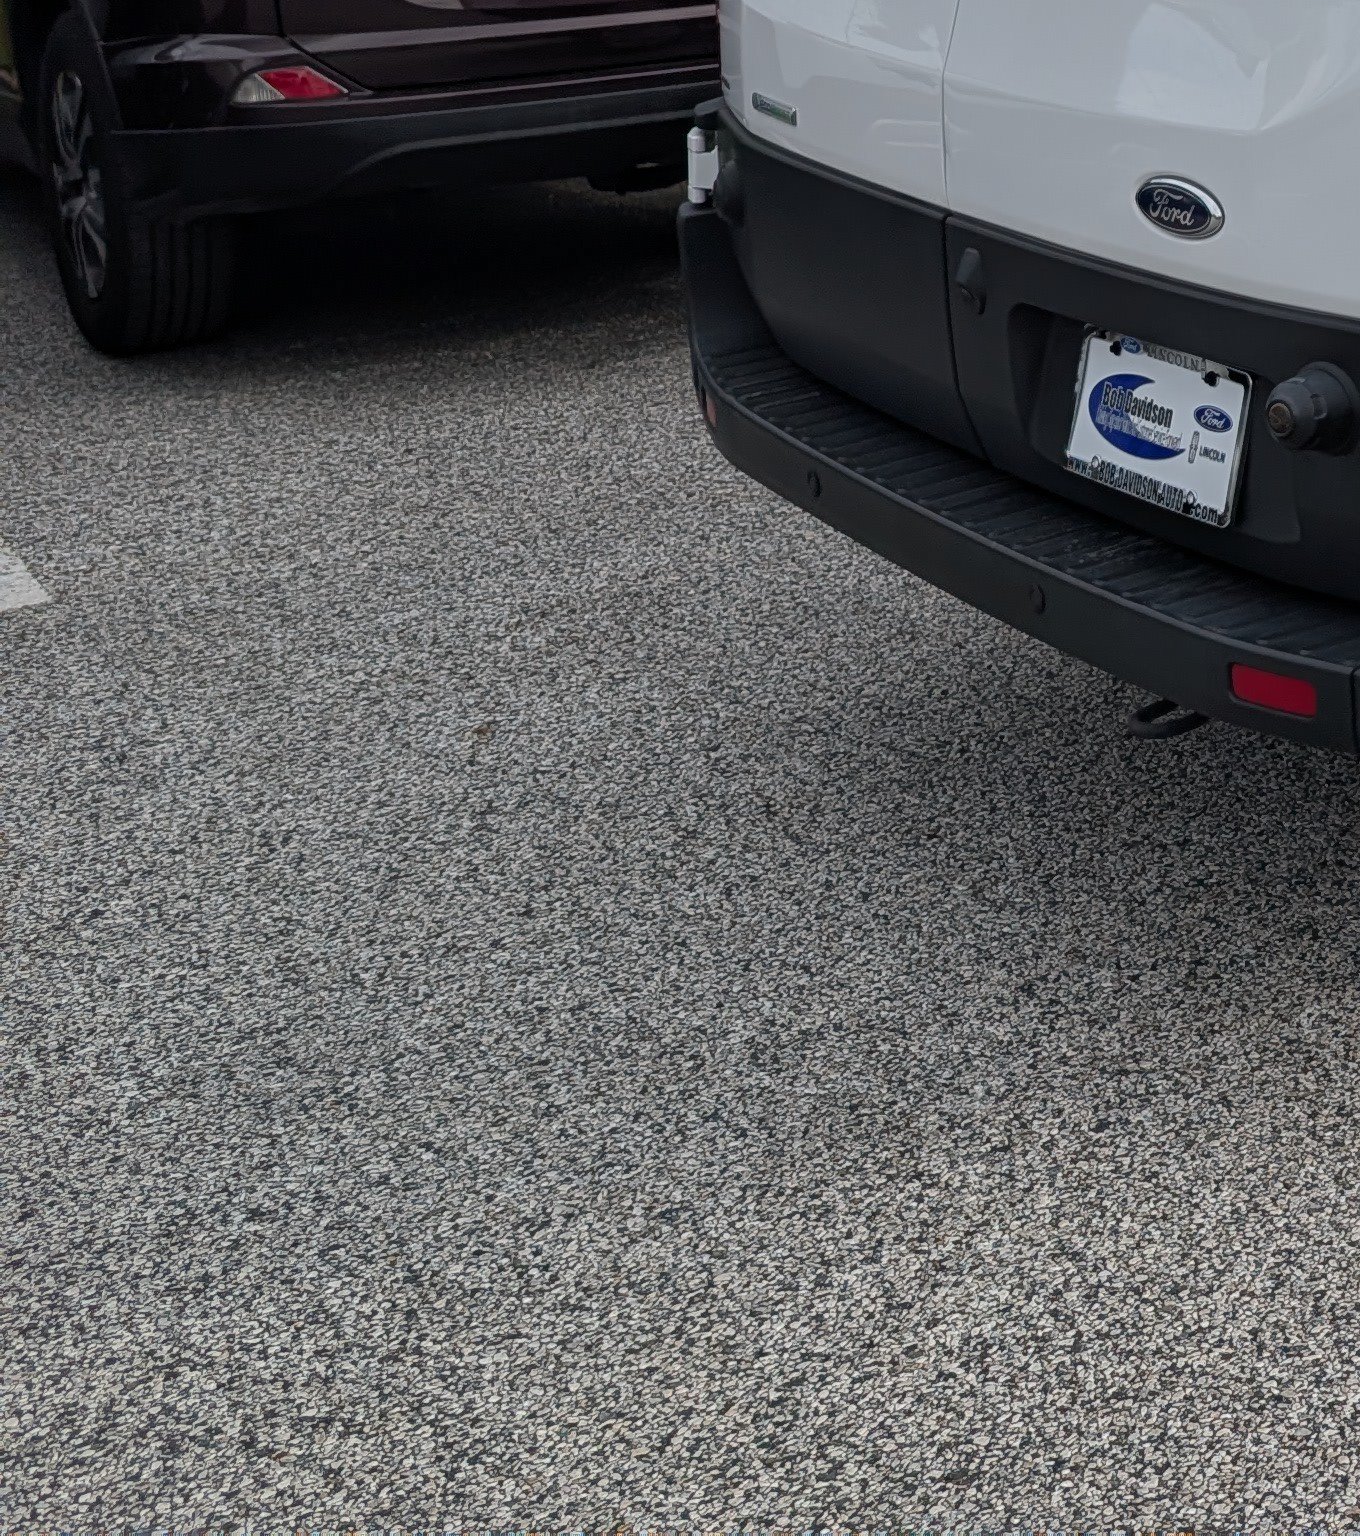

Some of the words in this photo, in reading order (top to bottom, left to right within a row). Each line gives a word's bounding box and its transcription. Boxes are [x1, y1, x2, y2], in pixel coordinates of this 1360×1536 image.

[1149, 189, 1196, 226] Ford
[1102, 382, 1124, 412] Bob
[1124, 389, 1174, 429] Davidson
[1200, 408, 1226, 429] Ford
[1199, 445, 1226, 464] LINCOLN
